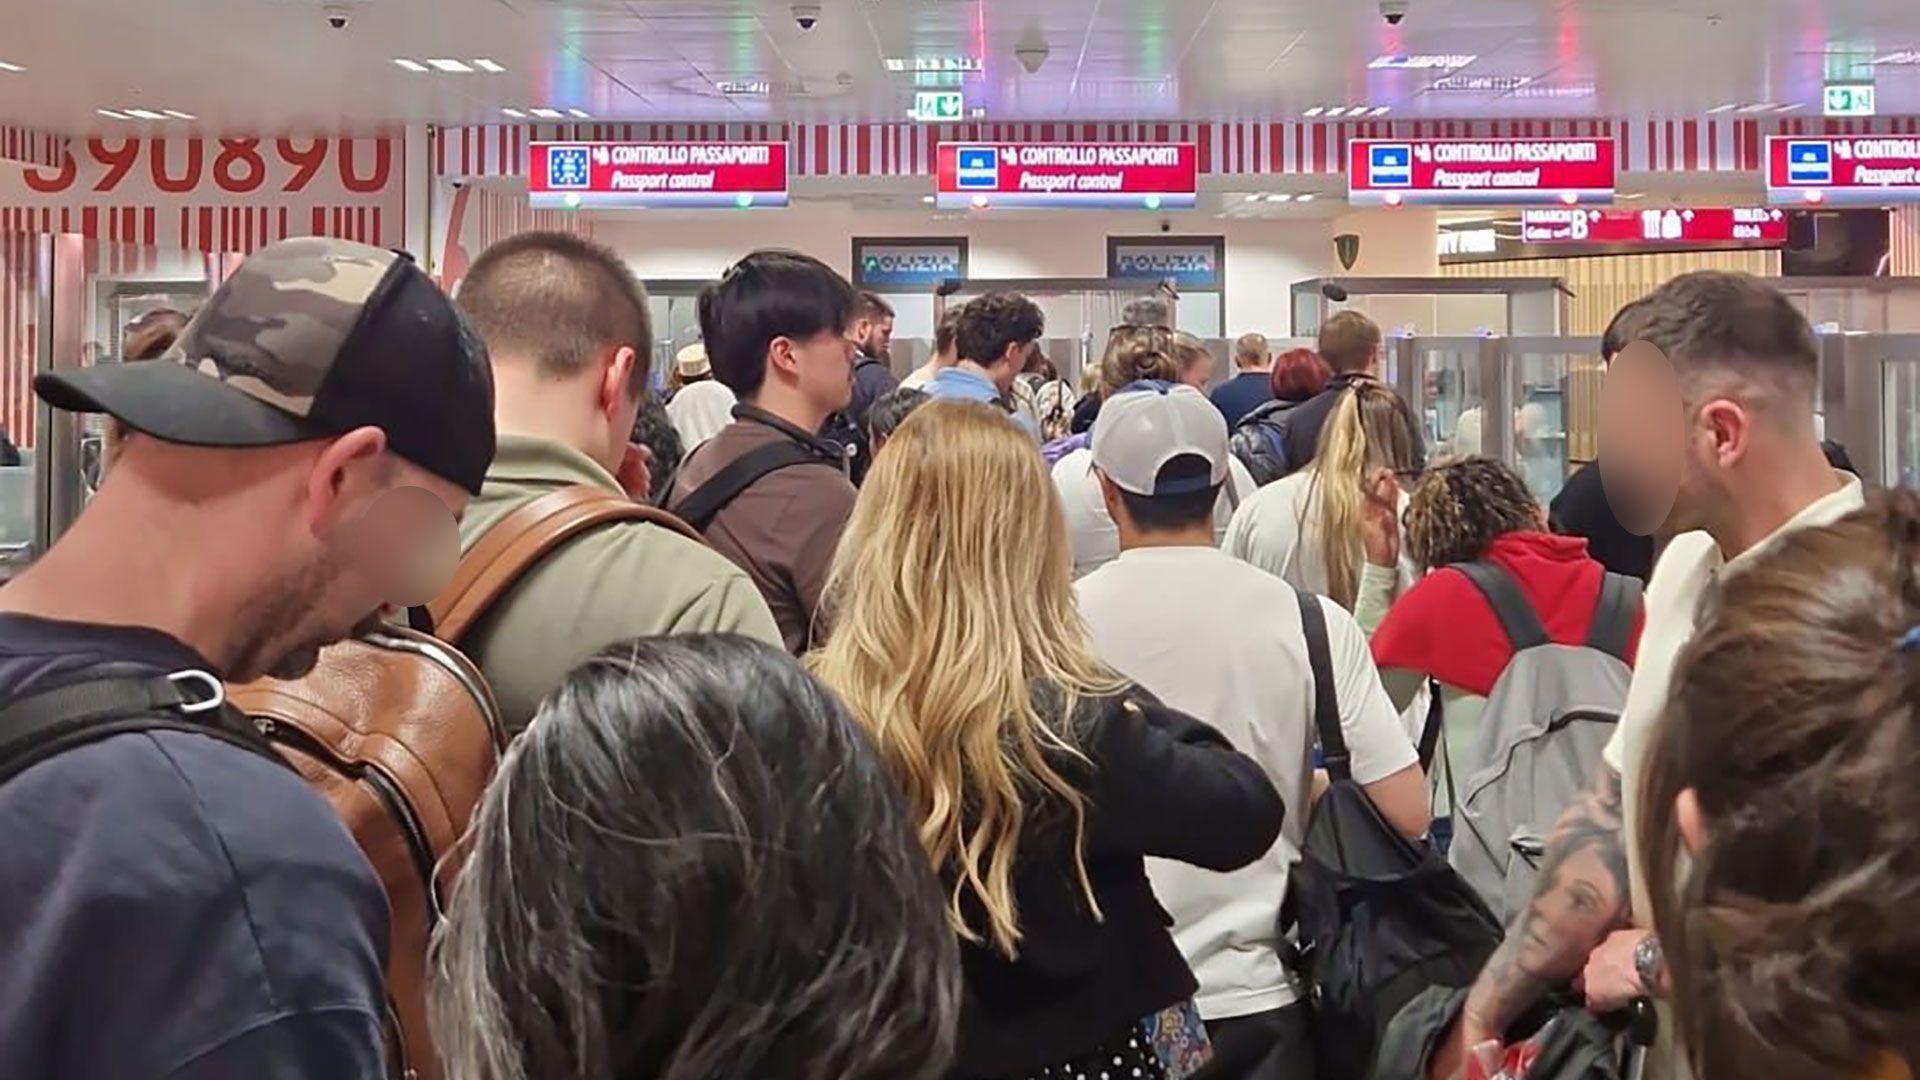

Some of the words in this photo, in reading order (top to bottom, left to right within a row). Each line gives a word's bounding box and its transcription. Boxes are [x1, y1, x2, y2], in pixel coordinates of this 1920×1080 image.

[611, 146, 688, 165] CONTROLLO
[690, 146, 769, 165] PASSAPORTI
[1020, 147, 1097, 166] CONTROLLO
[1098, 147, 1179, 166] PASSAPORTI
[1434, 143, 1512, 162] CONTROLLO
[1513, 143, 1597, 162] PASSAPORTI
[611, 171, 668, 192] Passport
[669, 171, 715, 189] control
[1019, 172, 1076, 192] Passport
[1077, 172, 1122, 190] control
[1433, 169, 1491, 189] Passport
[1492, 168, 1540, 187] control
[1853, 165, 1914, 187] Passport
[1572, 209, 1588, 240] B
[864, 255, 954, 273] POLIZIA
[1119, 254, 1210, 272] POLIZIA
